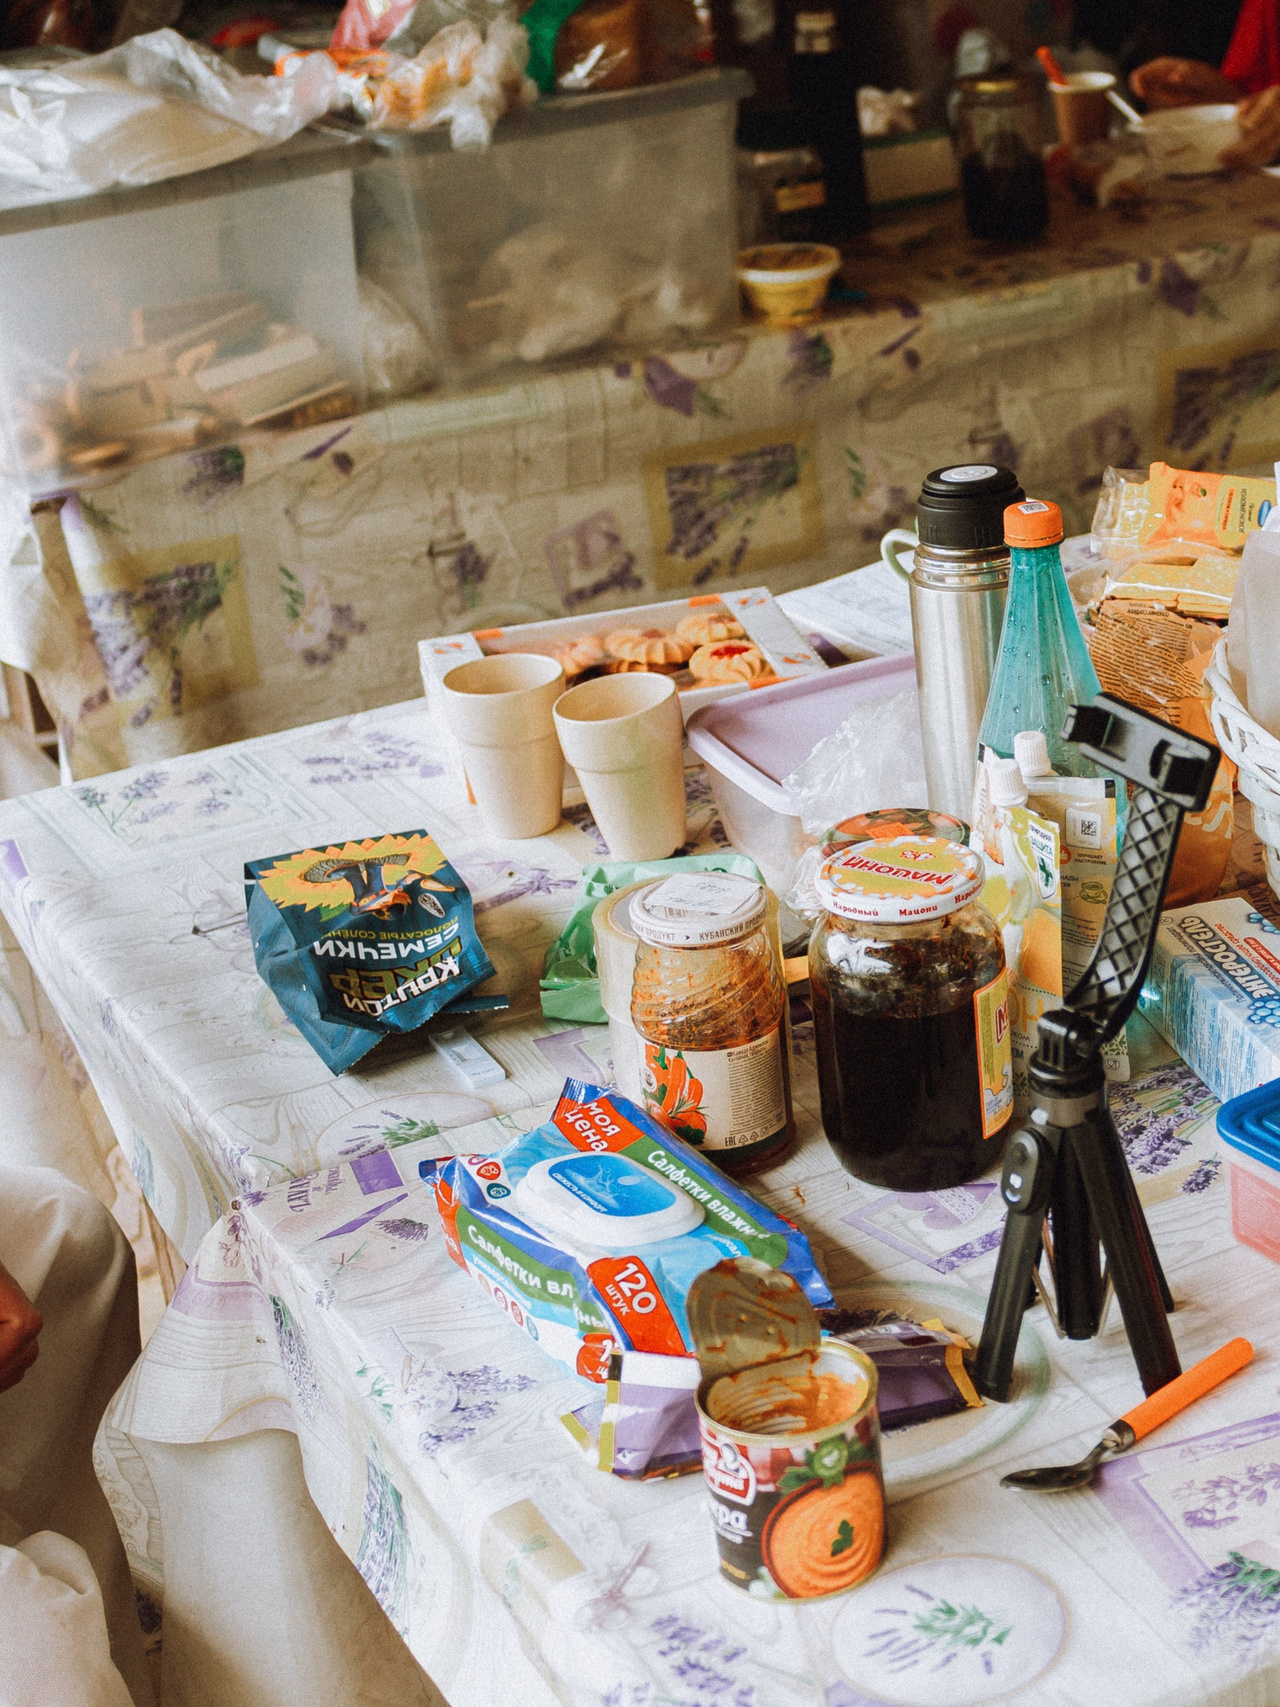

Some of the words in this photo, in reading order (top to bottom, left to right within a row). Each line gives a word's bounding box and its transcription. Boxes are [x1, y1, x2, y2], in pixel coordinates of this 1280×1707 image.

[842, 856, 953, 886] МАЦОНИ
[647, 928, 676, 942] ПРОДУКТ
[699, 923, 745, 941] КУБАНСКИЙ
[744, 908, 767, 932] ПРОДУКТ
[832, 900, 879, 917] Народный
[898, 904, 938, 917] Мацони
[314, 922, 460, 960] СЕМЕЧКИ
[1214, 923, 1240, 947] средство
[1179, 915, 1276, 1000] ЭНТЕРОСГЕЛЬ
[564, 1107, 609, 1152] цена
[583, 1101, 622, 1137] моя
[647, 1149, 713, 1203] Салфетки
[467, 1224, 542, 1289] Салфетки
[604, 1283, 631, 1316] штук
[613, 1262, 657, 1315] 120
